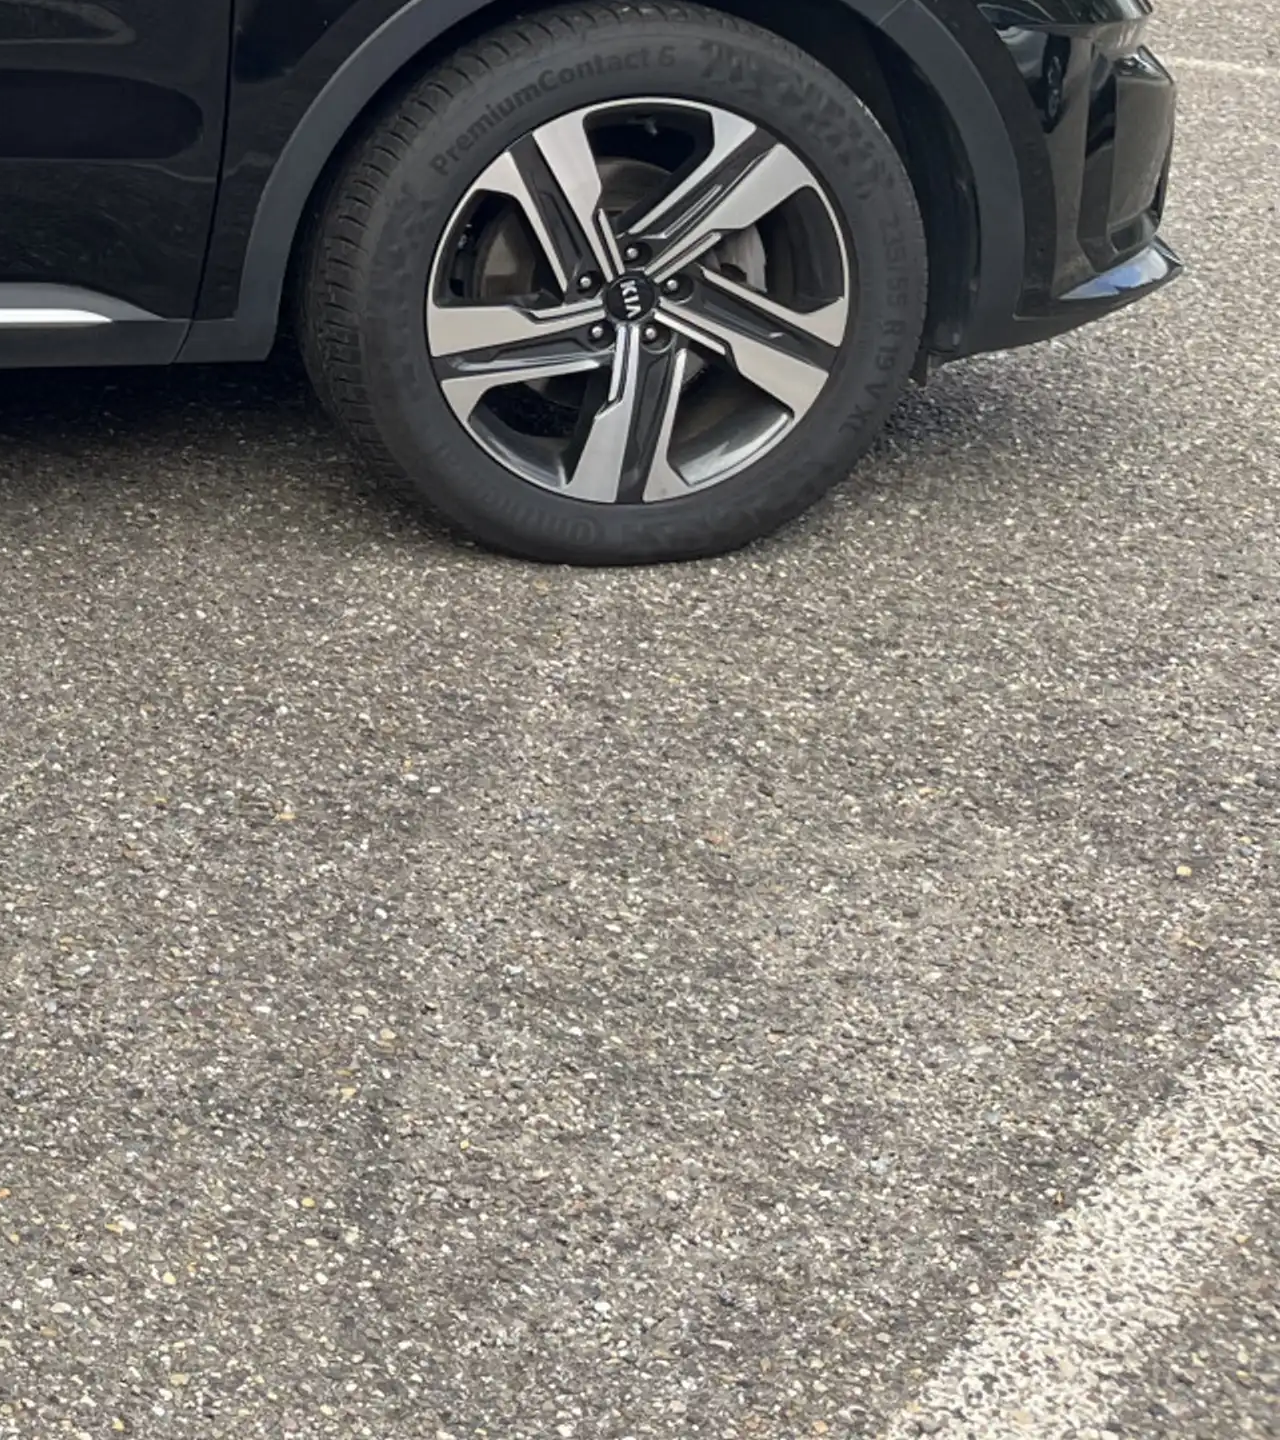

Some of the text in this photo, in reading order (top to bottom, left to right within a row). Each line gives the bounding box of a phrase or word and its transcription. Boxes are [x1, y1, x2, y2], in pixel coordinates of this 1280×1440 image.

[427, 44, 676, 176] PremiumContact 6
[620, 280, 642, 319] KIA
